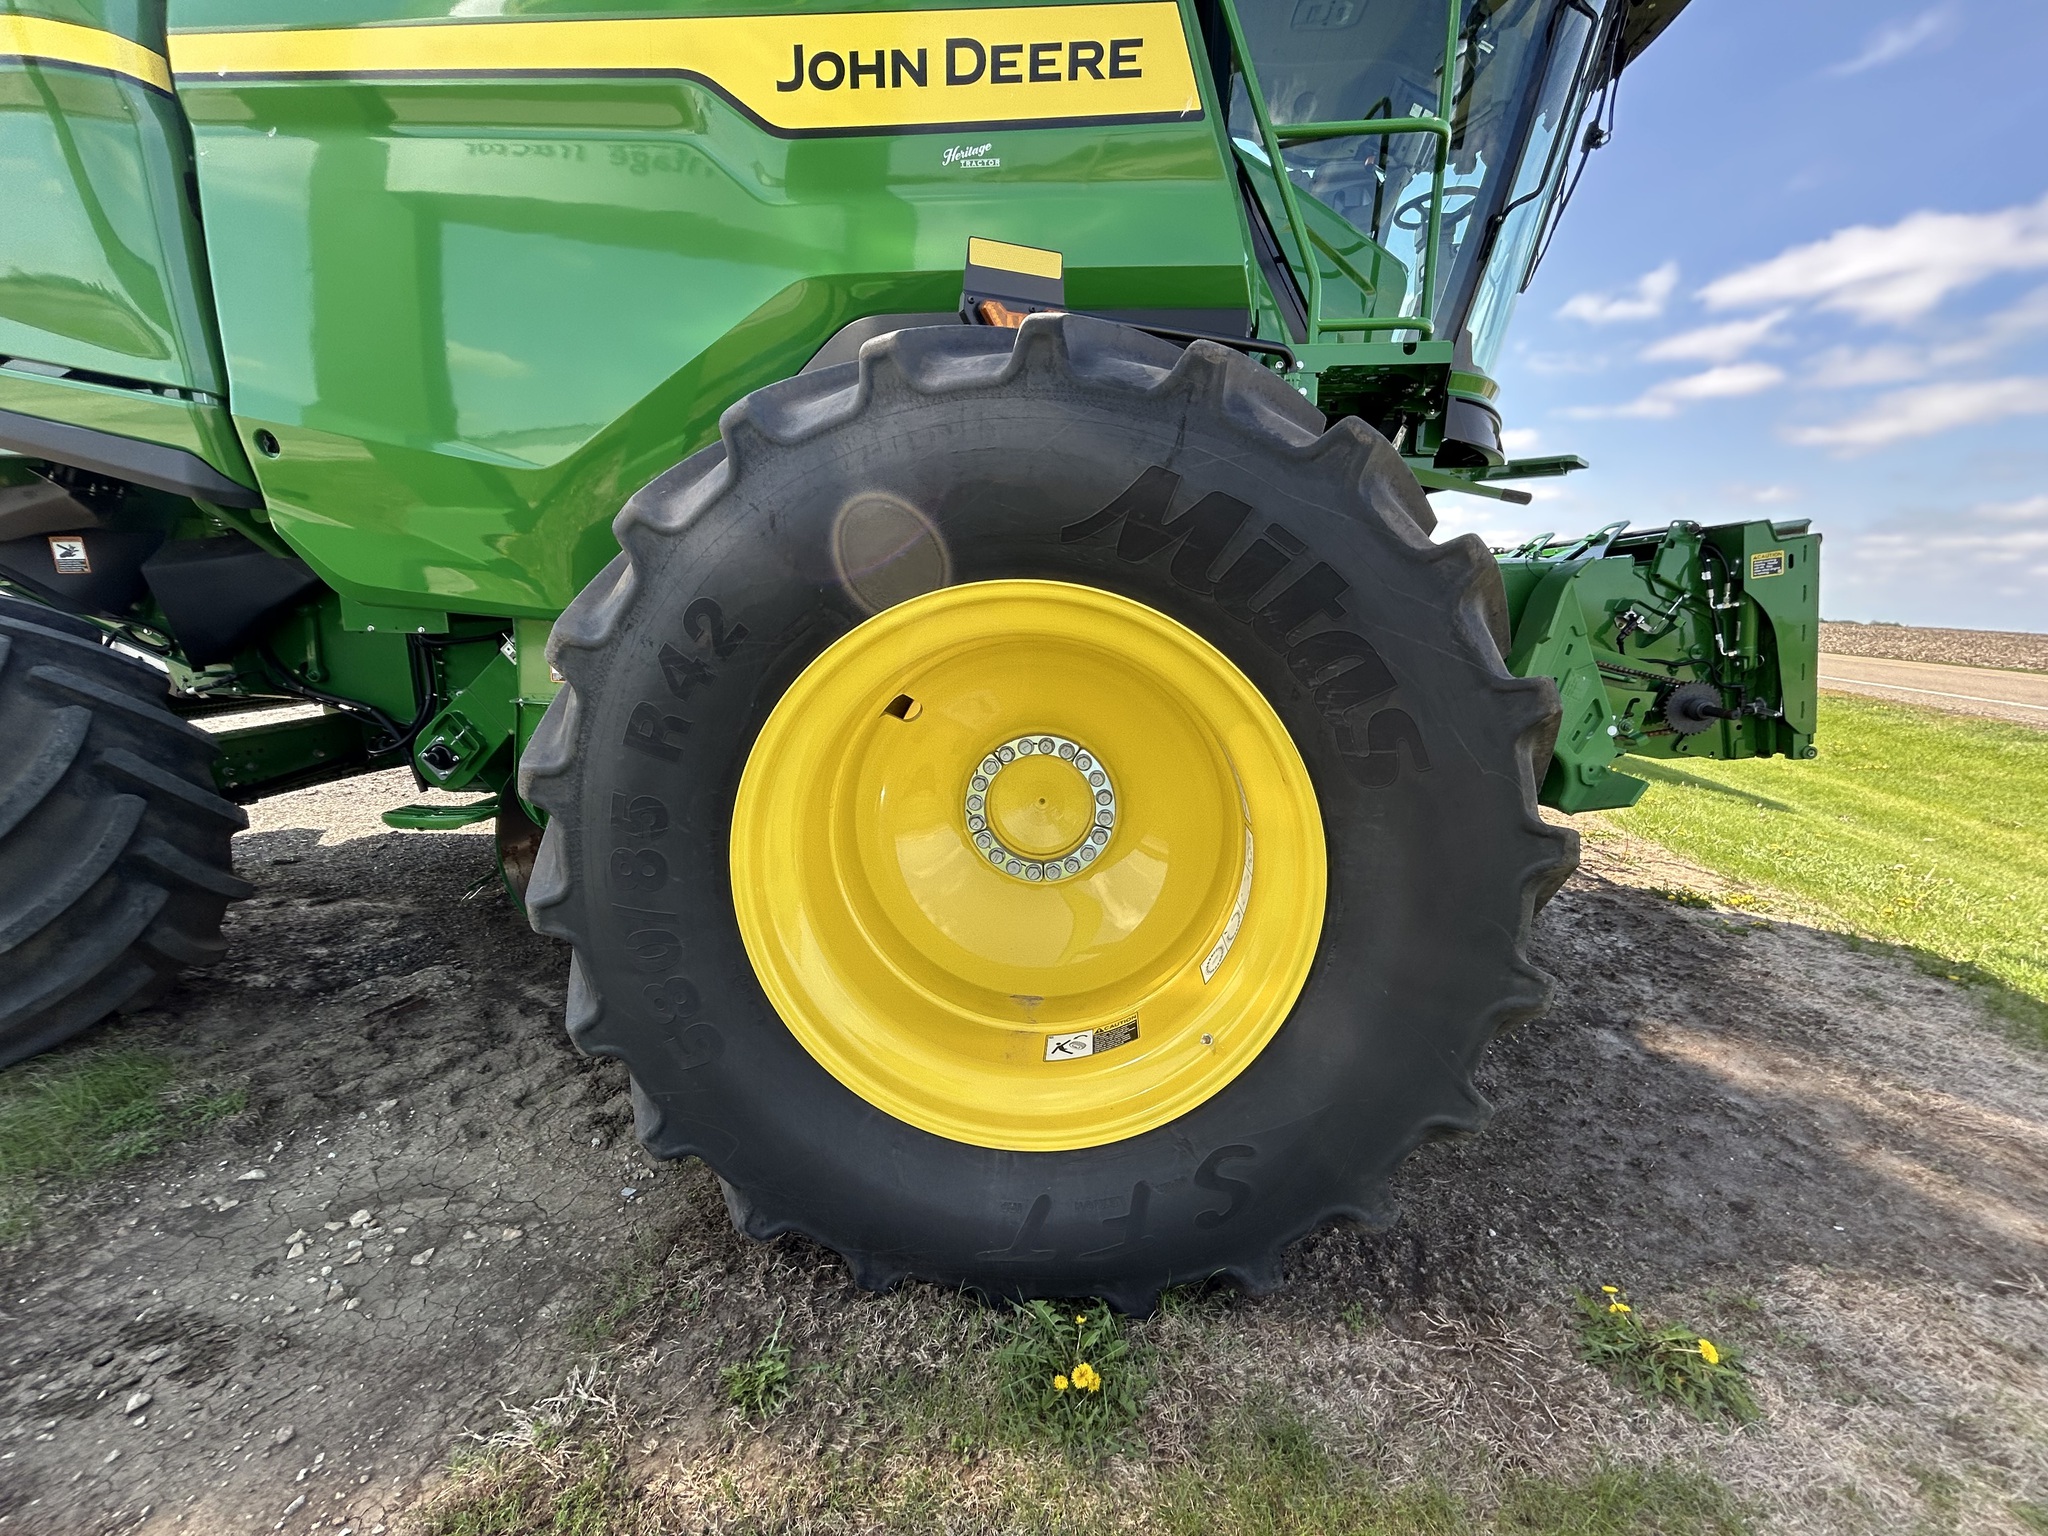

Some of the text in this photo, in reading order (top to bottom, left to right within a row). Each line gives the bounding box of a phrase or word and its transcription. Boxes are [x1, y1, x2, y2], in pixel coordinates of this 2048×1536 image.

[776, 38, 1144, 92] JOHN DEERE
[942, 143, 992, 166] Heritage
[960, 158, 1000, 168] TRACTOR
[1059, 465, 1432, 788] Mitas
[610, 791, 727, 1071] 580/85
[1104, 1014, 1137, 1031] CAUTION
